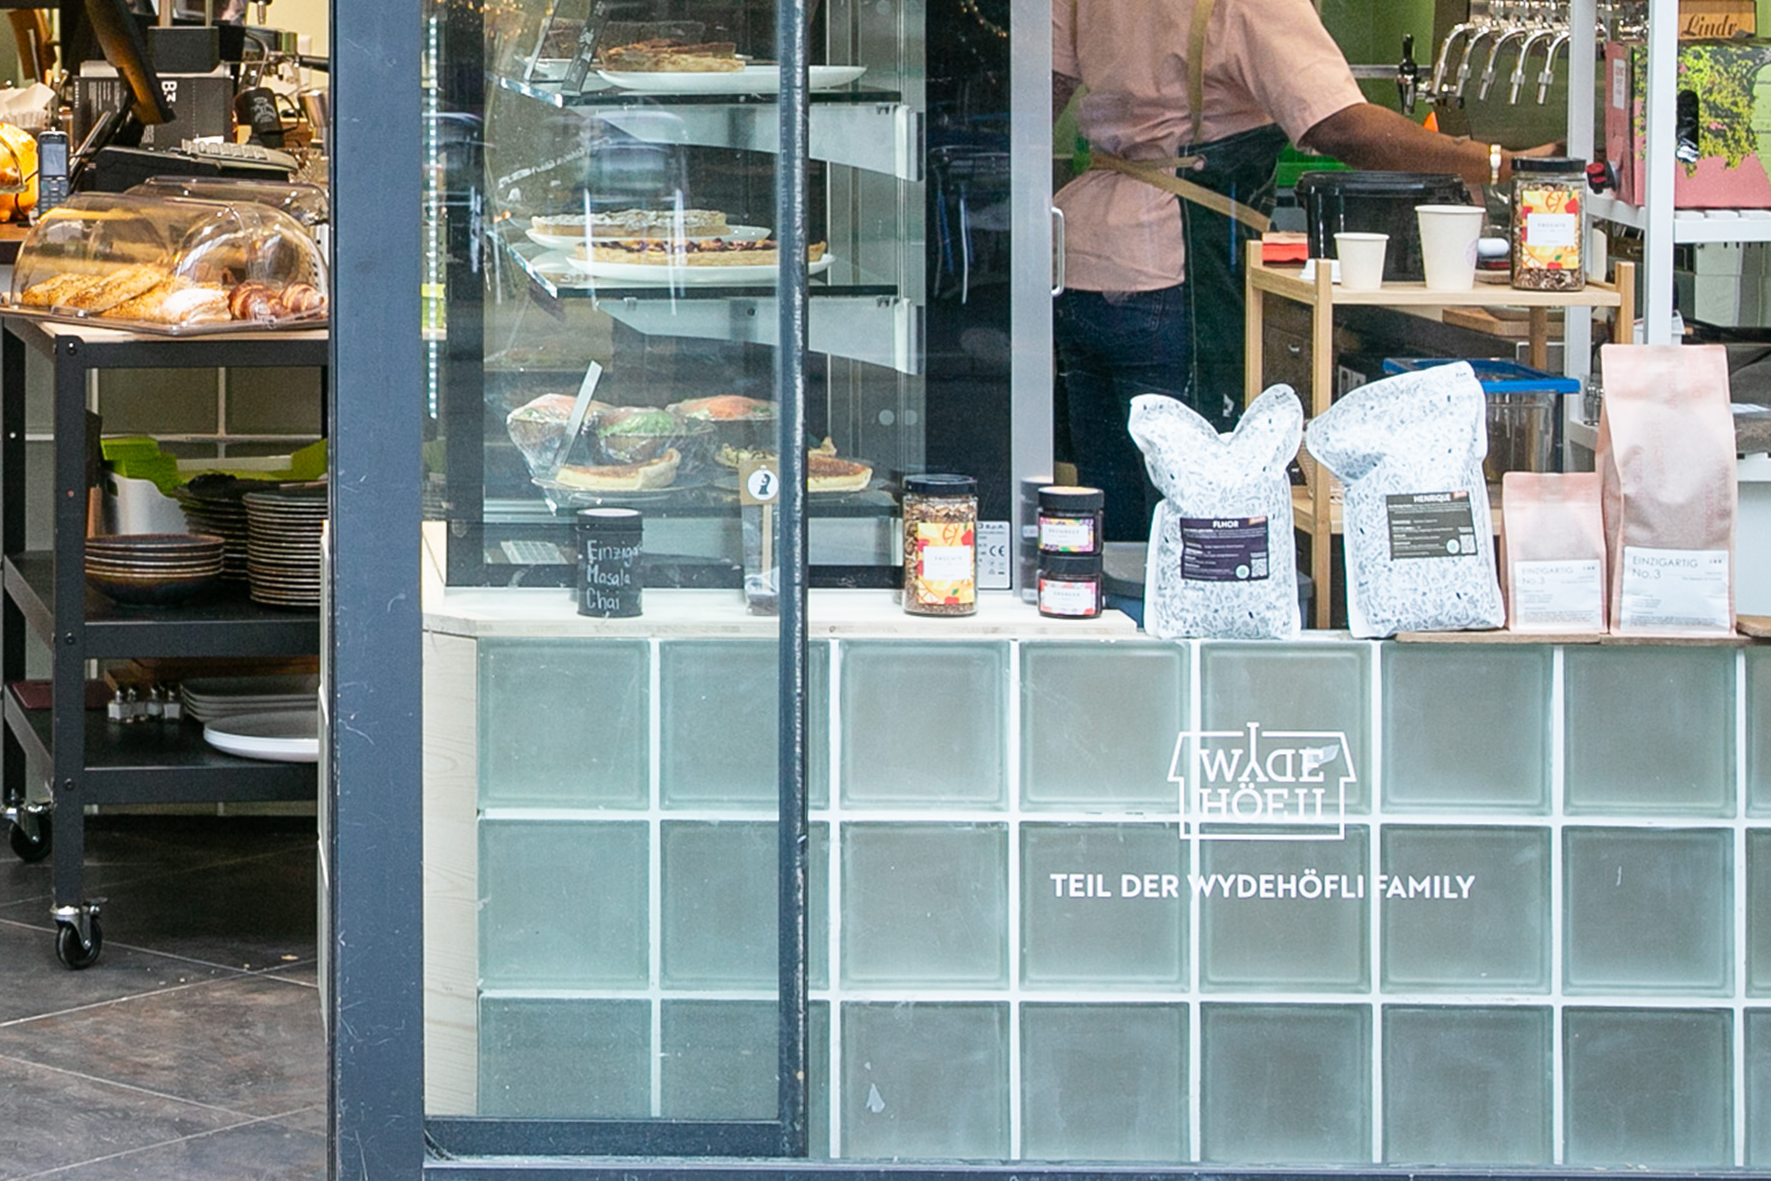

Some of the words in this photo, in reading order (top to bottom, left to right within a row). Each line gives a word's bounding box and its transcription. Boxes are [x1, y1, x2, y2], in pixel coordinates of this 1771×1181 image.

[1633, 556, 1699, 567] EINZIGARTIG
[1522, 566, 1574, 575] EINZIGARTIG
[586, 587, 620, 610] Chai
[1050, 873, 1112, 899] TEIL
[1120, 873, 1180, 899] DER
[1188, 868, 1365, 899] WYDEHÖFLI
[1374, 873, 1477, 900] FAMILY
